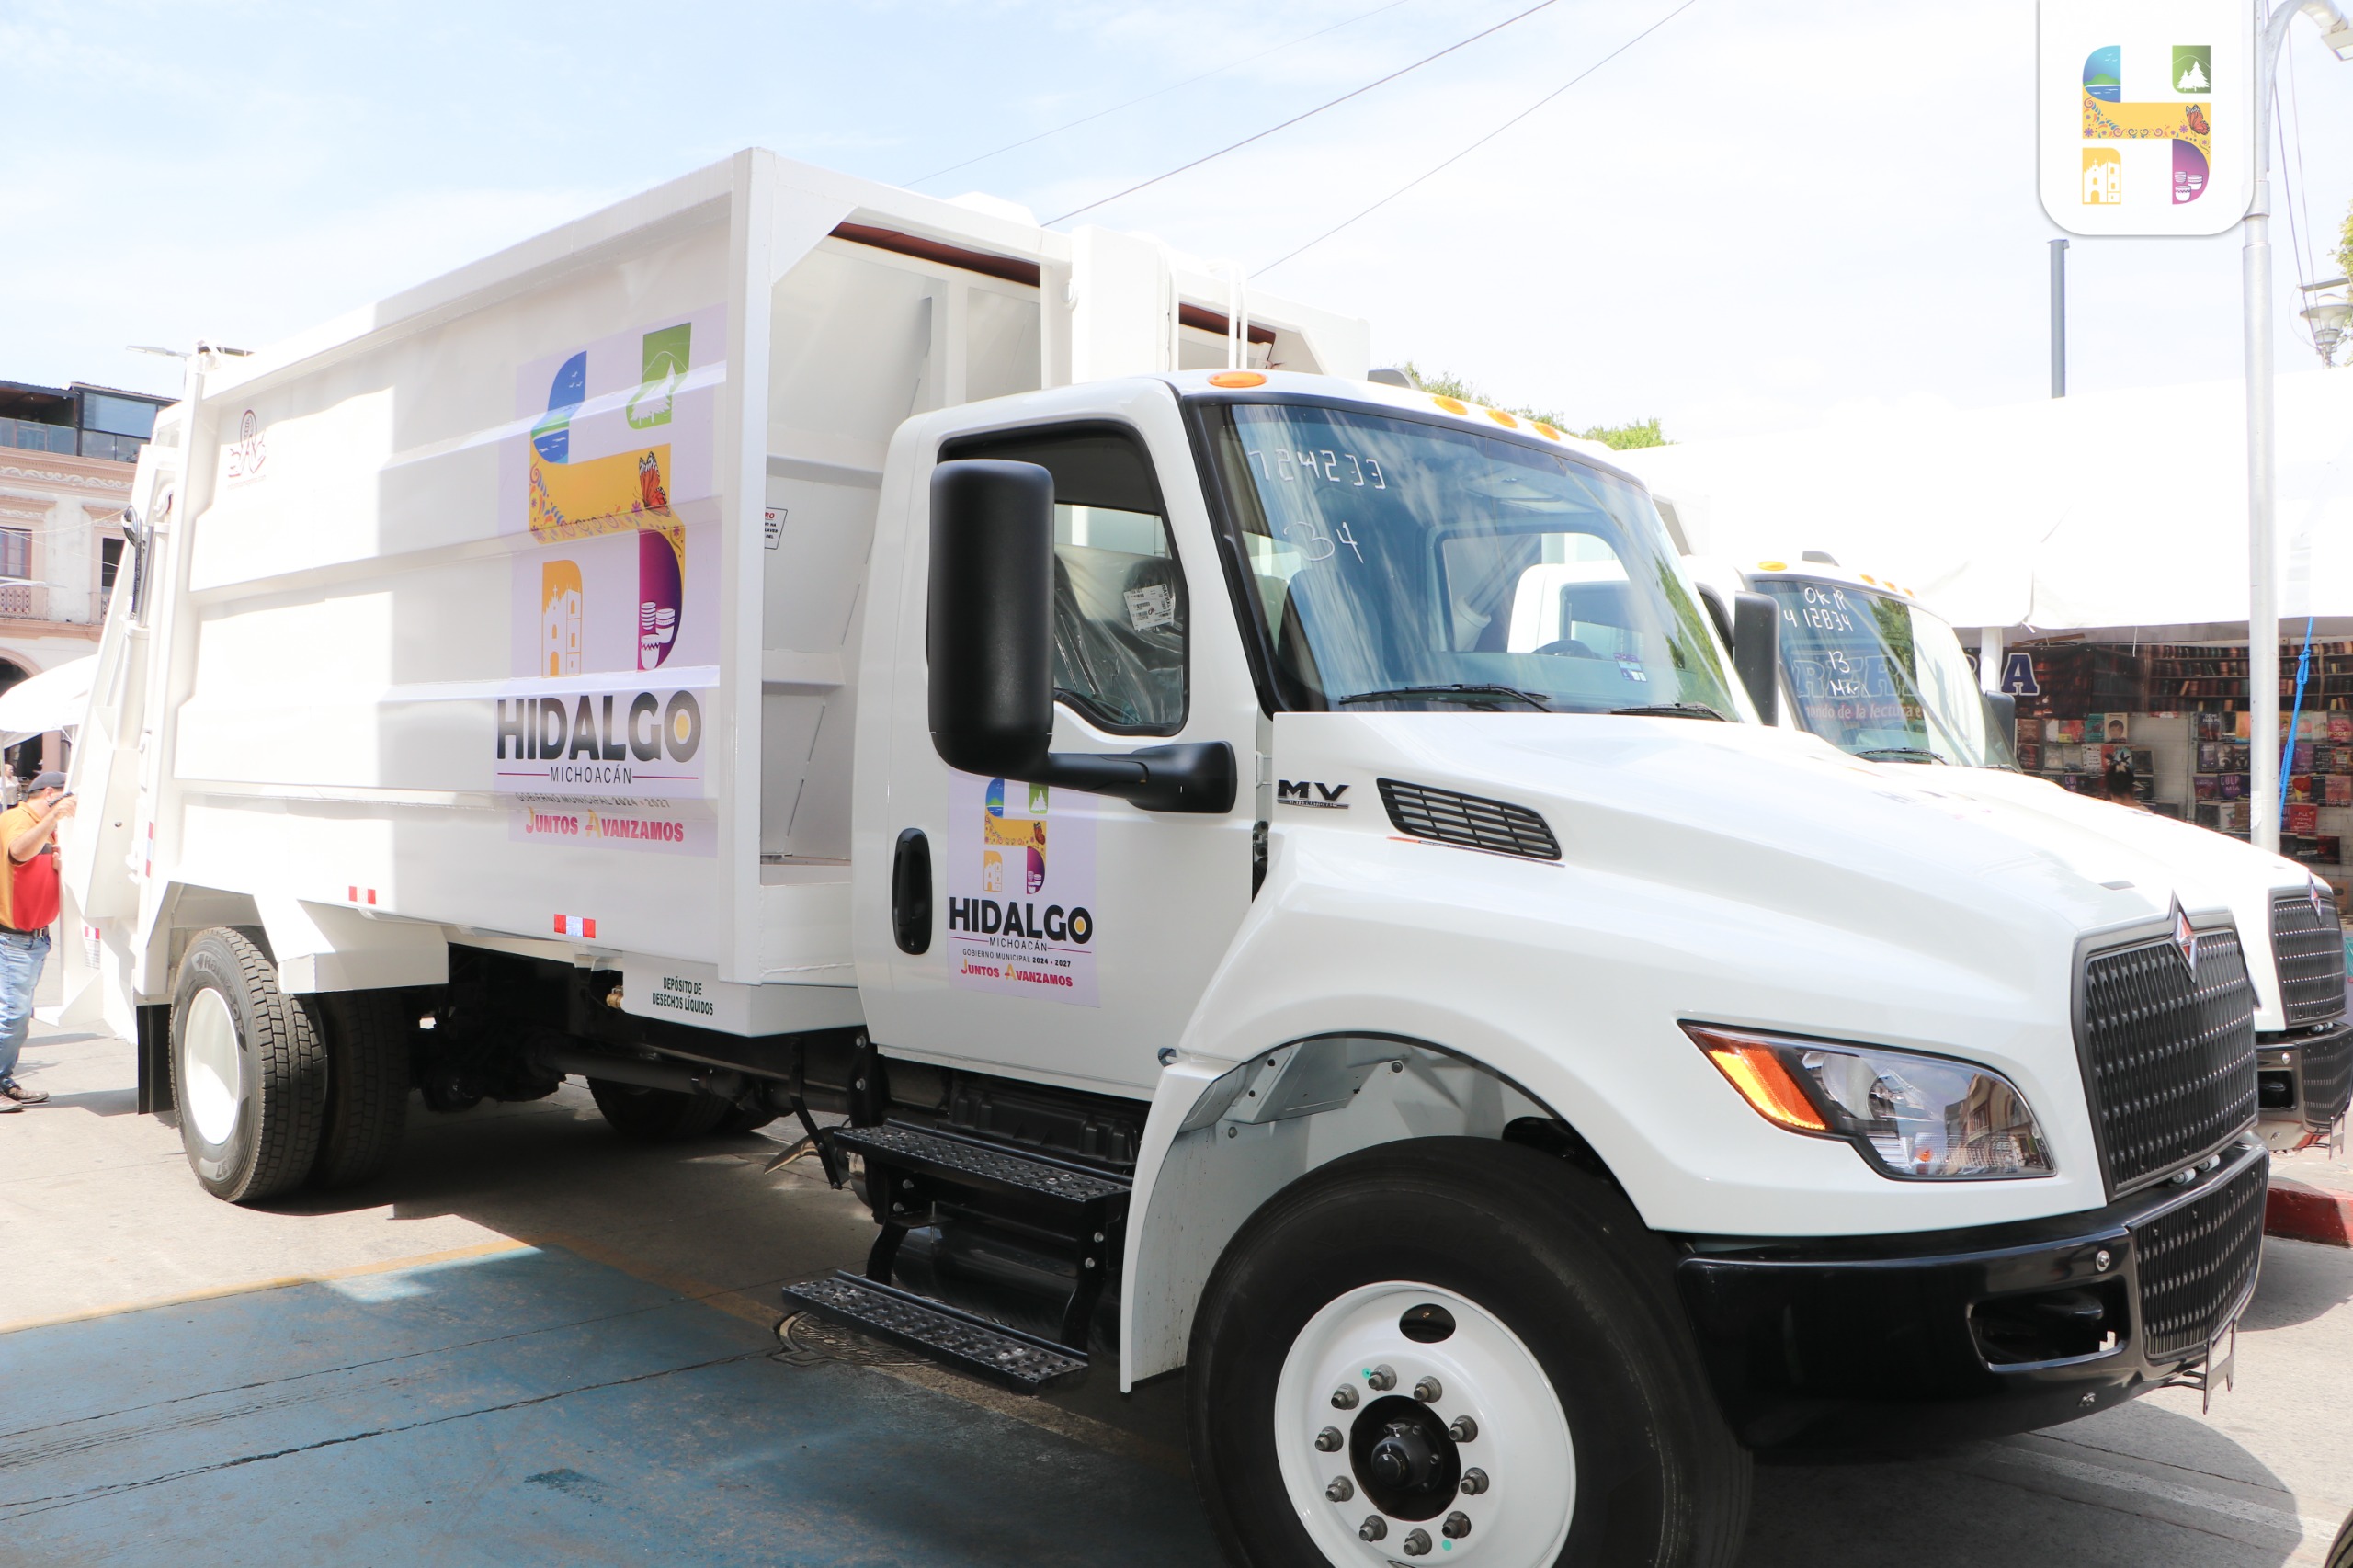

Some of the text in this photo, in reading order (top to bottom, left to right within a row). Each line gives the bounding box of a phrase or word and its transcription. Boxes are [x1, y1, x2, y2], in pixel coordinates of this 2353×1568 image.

[1838, 704, 1851, 719] de
[1856, 704, 1866, 719] la
[497, 689, 702, 763] HIDALGO
[550, 764, 631, 784] MICHOACÁN
[1278, 779, 1351, 801] MV
[516, 791, 561, 803] GOBIERNO
[562, 793, 612, 806] MUNICIPAL
[613, 796, 638, 807] 2024
[645, 799, 671, 809] 2027
[949, 897, 1093, 944] HIDALGO
[990, 937, 1047, 952] MICHOACÁN
[963, 949, 994, 959] GOBIERNO
[995, 951, 1030, 963] MUNICIPAL
[1032, 957, 1049, 965] 2024
[1054, 960, 1071, 968] 2027
[663, 976, 702, 995] DEPÓSITO DE
[652, 992, 713, 1016] DESECHOS LÍQUIDOS
